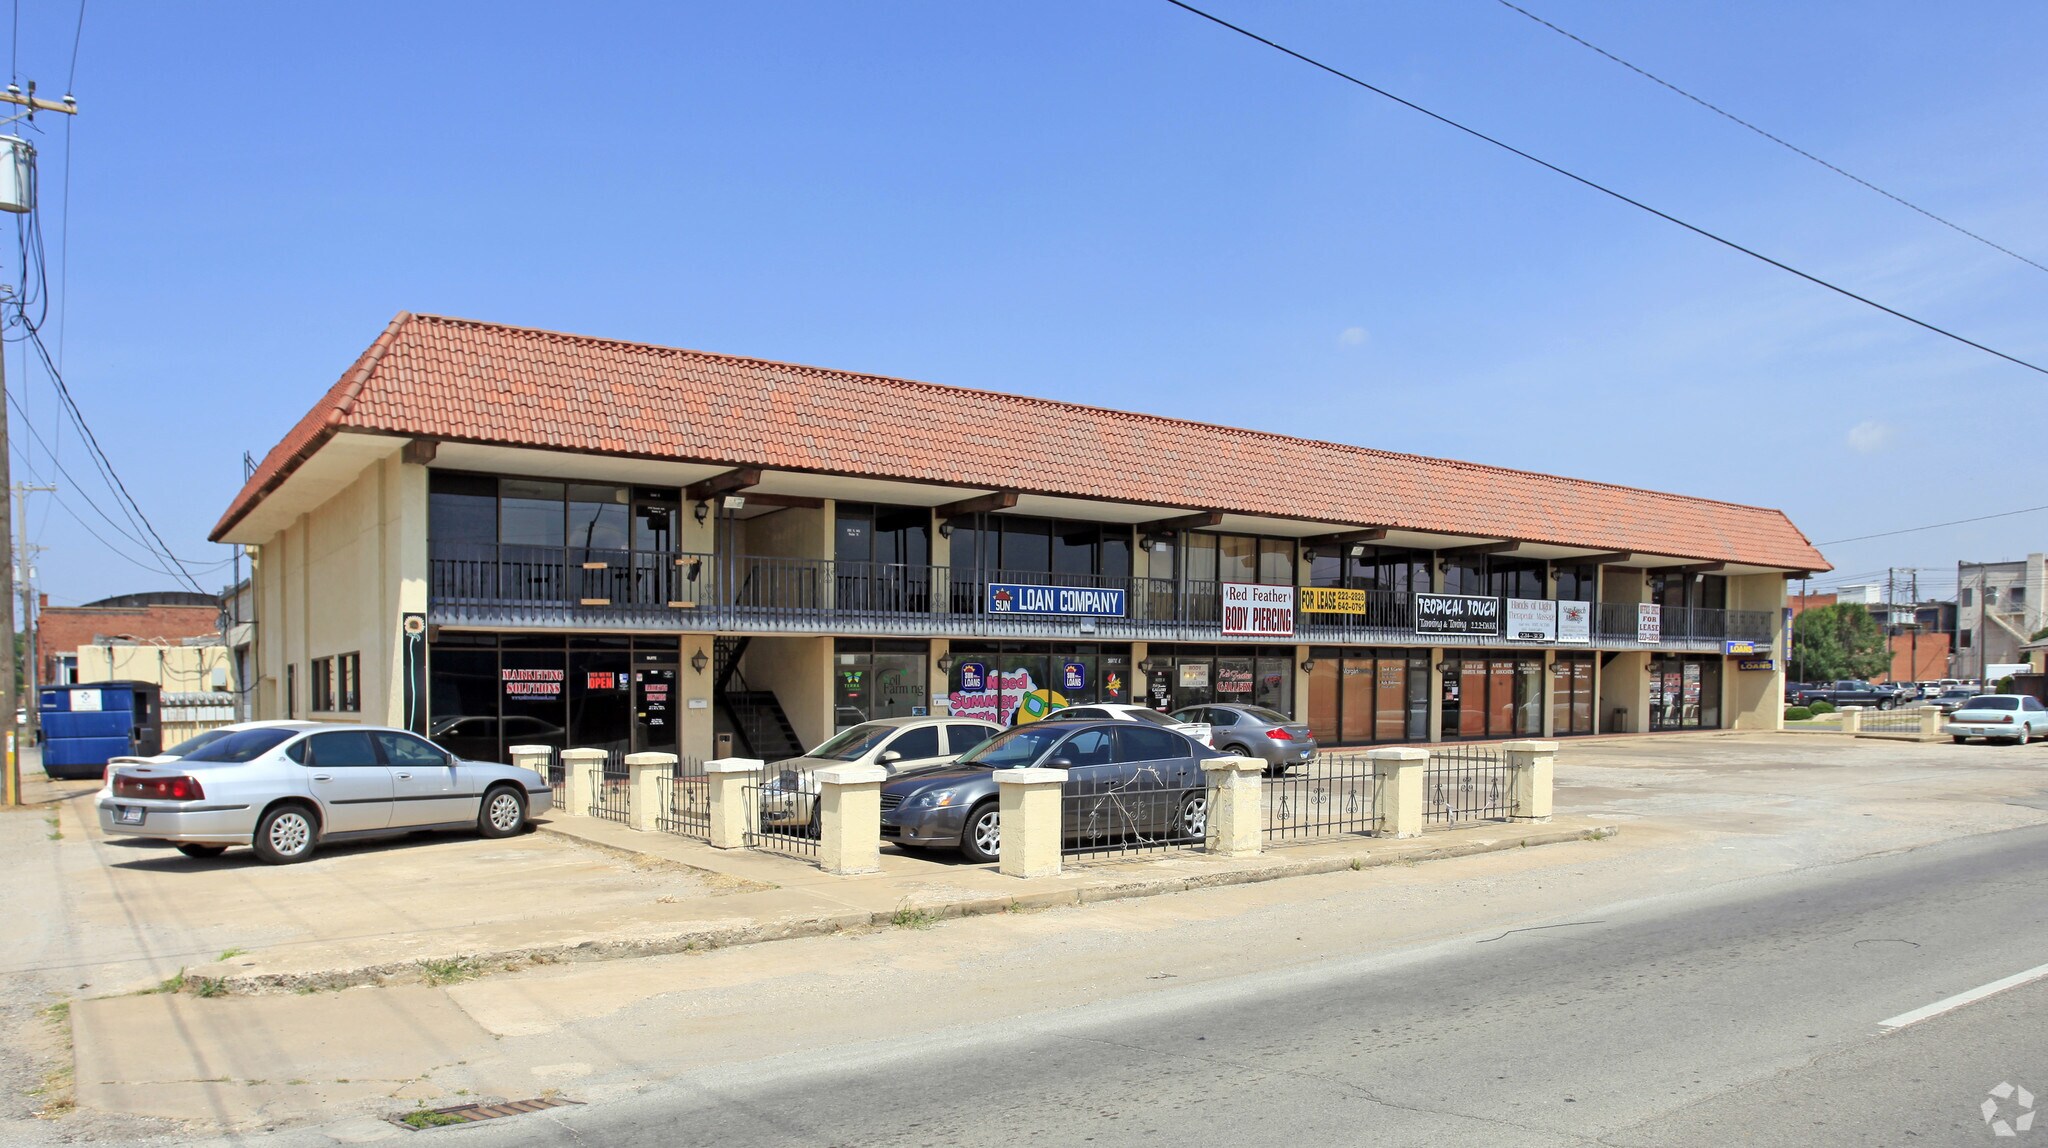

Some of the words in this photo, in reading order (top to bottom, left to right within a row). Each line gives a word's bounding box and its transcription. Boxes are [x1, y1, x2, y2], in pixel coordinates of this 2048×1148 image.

[1229, 586, 1247, 601] Red
[1253, 588, 1288, 603] Feather
[1301, 590, 1314, 609] FOR
[1317, 591, 1336, 610] LEASE
[1338, 592, 1365, 601] 222-2828
[995, 600, 1011, 611] SUN
[1019, 588, 1054, 611] LOAN
[1060, 590, 1118, 613] COMPANY
[1338, 602, 1365, 611] 642-0791
[1419, 598, 1464, 616] TROPICAL
[1467, 600, 1496, 617] TOUCH
[1511, 601, 1528, 610] Hands
[1539, 602, 1552, 612] Light
[1225, 606, 1249, 631] BODY
[1253, 607, 1291, 632] PIERCING
[1419, 619, 1442, 631] Tanning
[1443, 620, 1448, 628] &
[1449, 619, 1467, 631] Toning
[1730, 645, 1753, 653] LOANS
[502, 669, 564, 680] MARKETING
[590, 677, 613, 688] OPEN
[965, 678, 981, 687] LOANS
[987, 673, 1028, 690] Need
[1067, 678, 1082, 687] LOANS
[1217, 681, 1254, 692] GALLERY
[506, 682, 560, 694] SOLUTIONS
[883, 683, 924, 696] Farmng
[950, 692, 1018, 709] Summer
